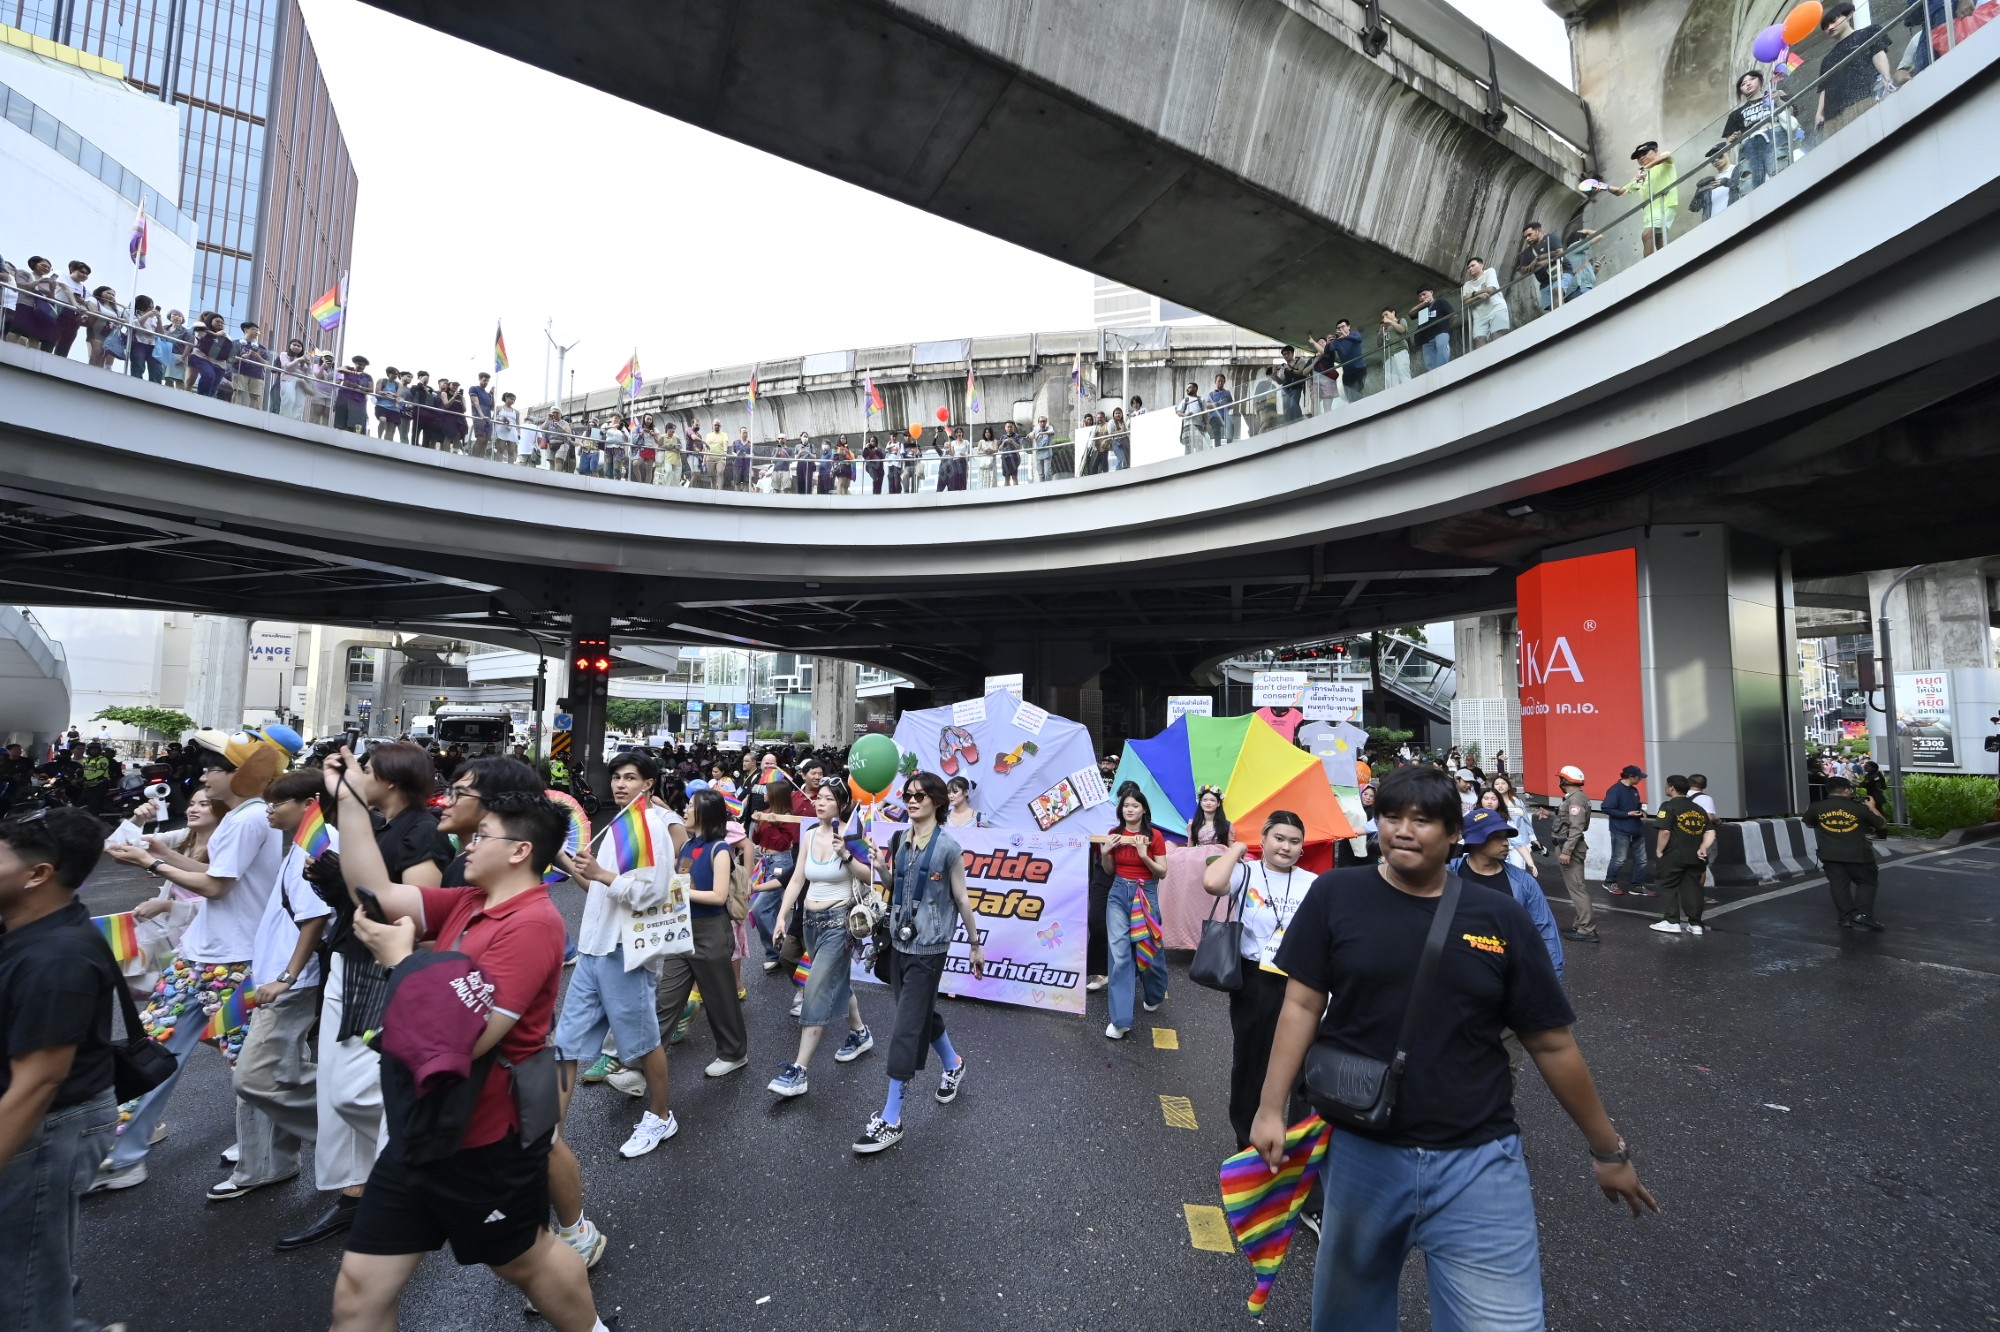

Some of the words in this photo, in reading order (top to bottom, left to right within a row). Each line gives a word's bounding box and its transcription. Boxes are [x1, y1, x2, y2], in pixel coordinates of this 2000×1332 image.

[1263, 675, 1295, 683] Clothes
[1915, 677, 1942, 687] หยุด
[1253, 683, 1275, 691] don't
[1277, 683, 1304, 691] define
[1262, 692, 1296, 700] consent
[1917, 698, 1944, 709] หยุด
